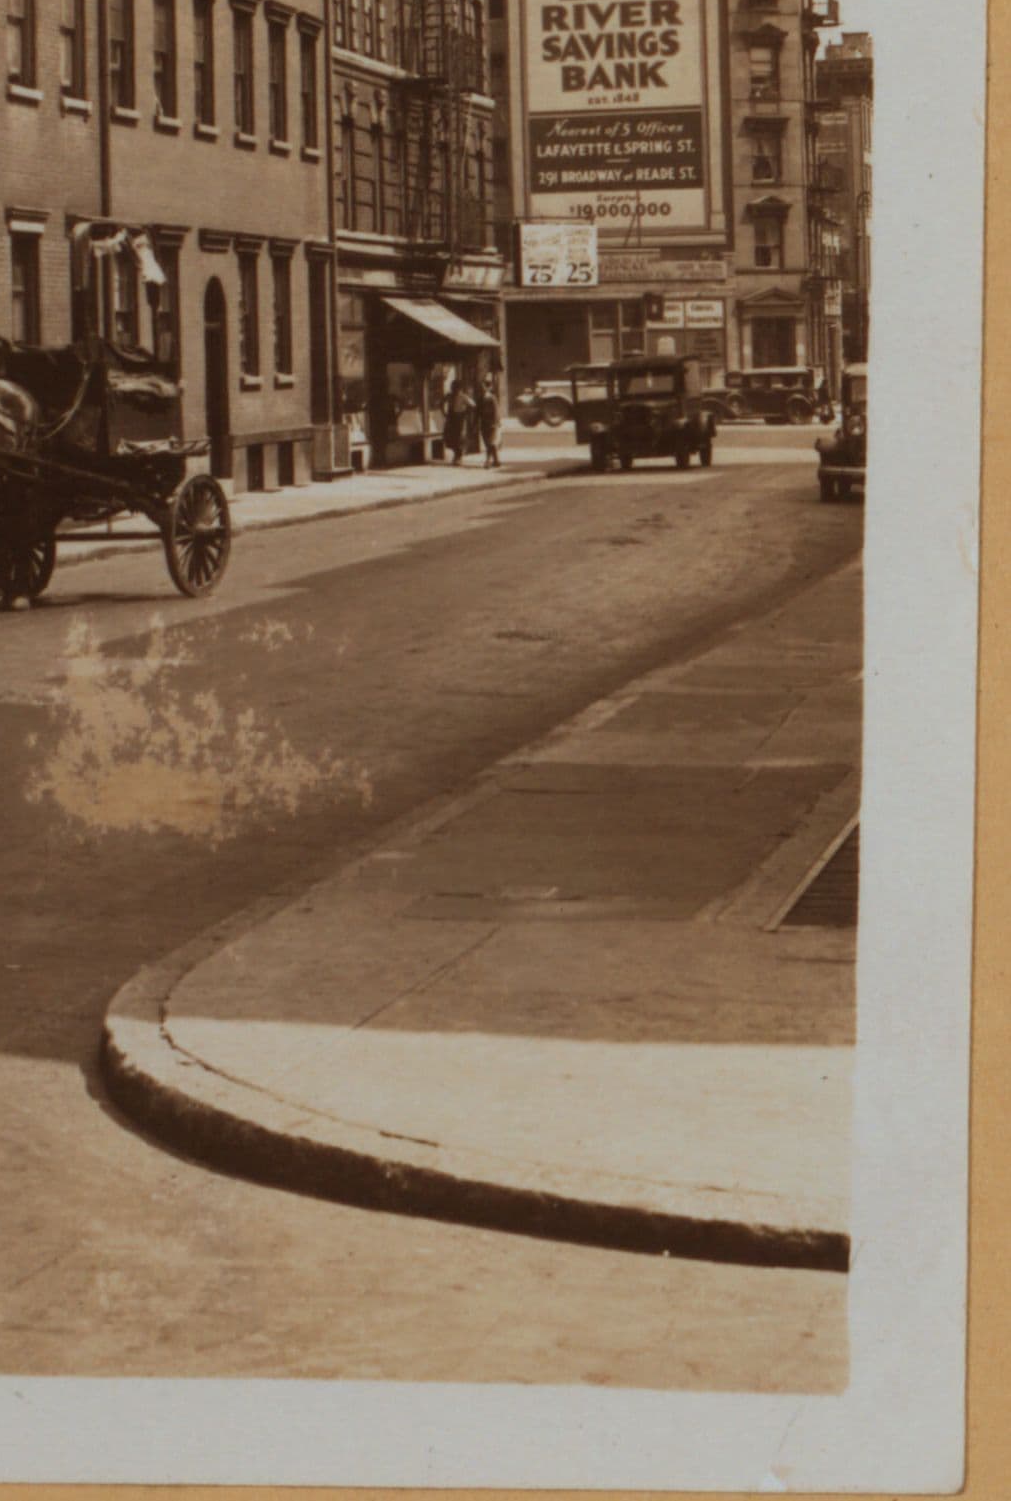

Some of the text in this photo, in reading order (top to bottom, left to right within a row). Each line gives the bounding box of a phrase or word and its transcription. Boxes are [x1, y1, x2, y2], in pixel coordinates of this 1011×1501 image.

[541, 0, 683, 32] RIVER
[541, 29, 680, 62] SAVINGS
[561, 61, 668, 92] BANK
[546, 118, 684, 138] Nearest of 5 Offices
[536, 141, 611, 158] LAFAYETTE
[624, 140, 673, 155] SPRING
[677, 139, 696, 154] ST.
[561, 168, 623, 184] BROADWAY
[636, 166, 675, 181] READE
[679, 165, 697, 180] ST.
